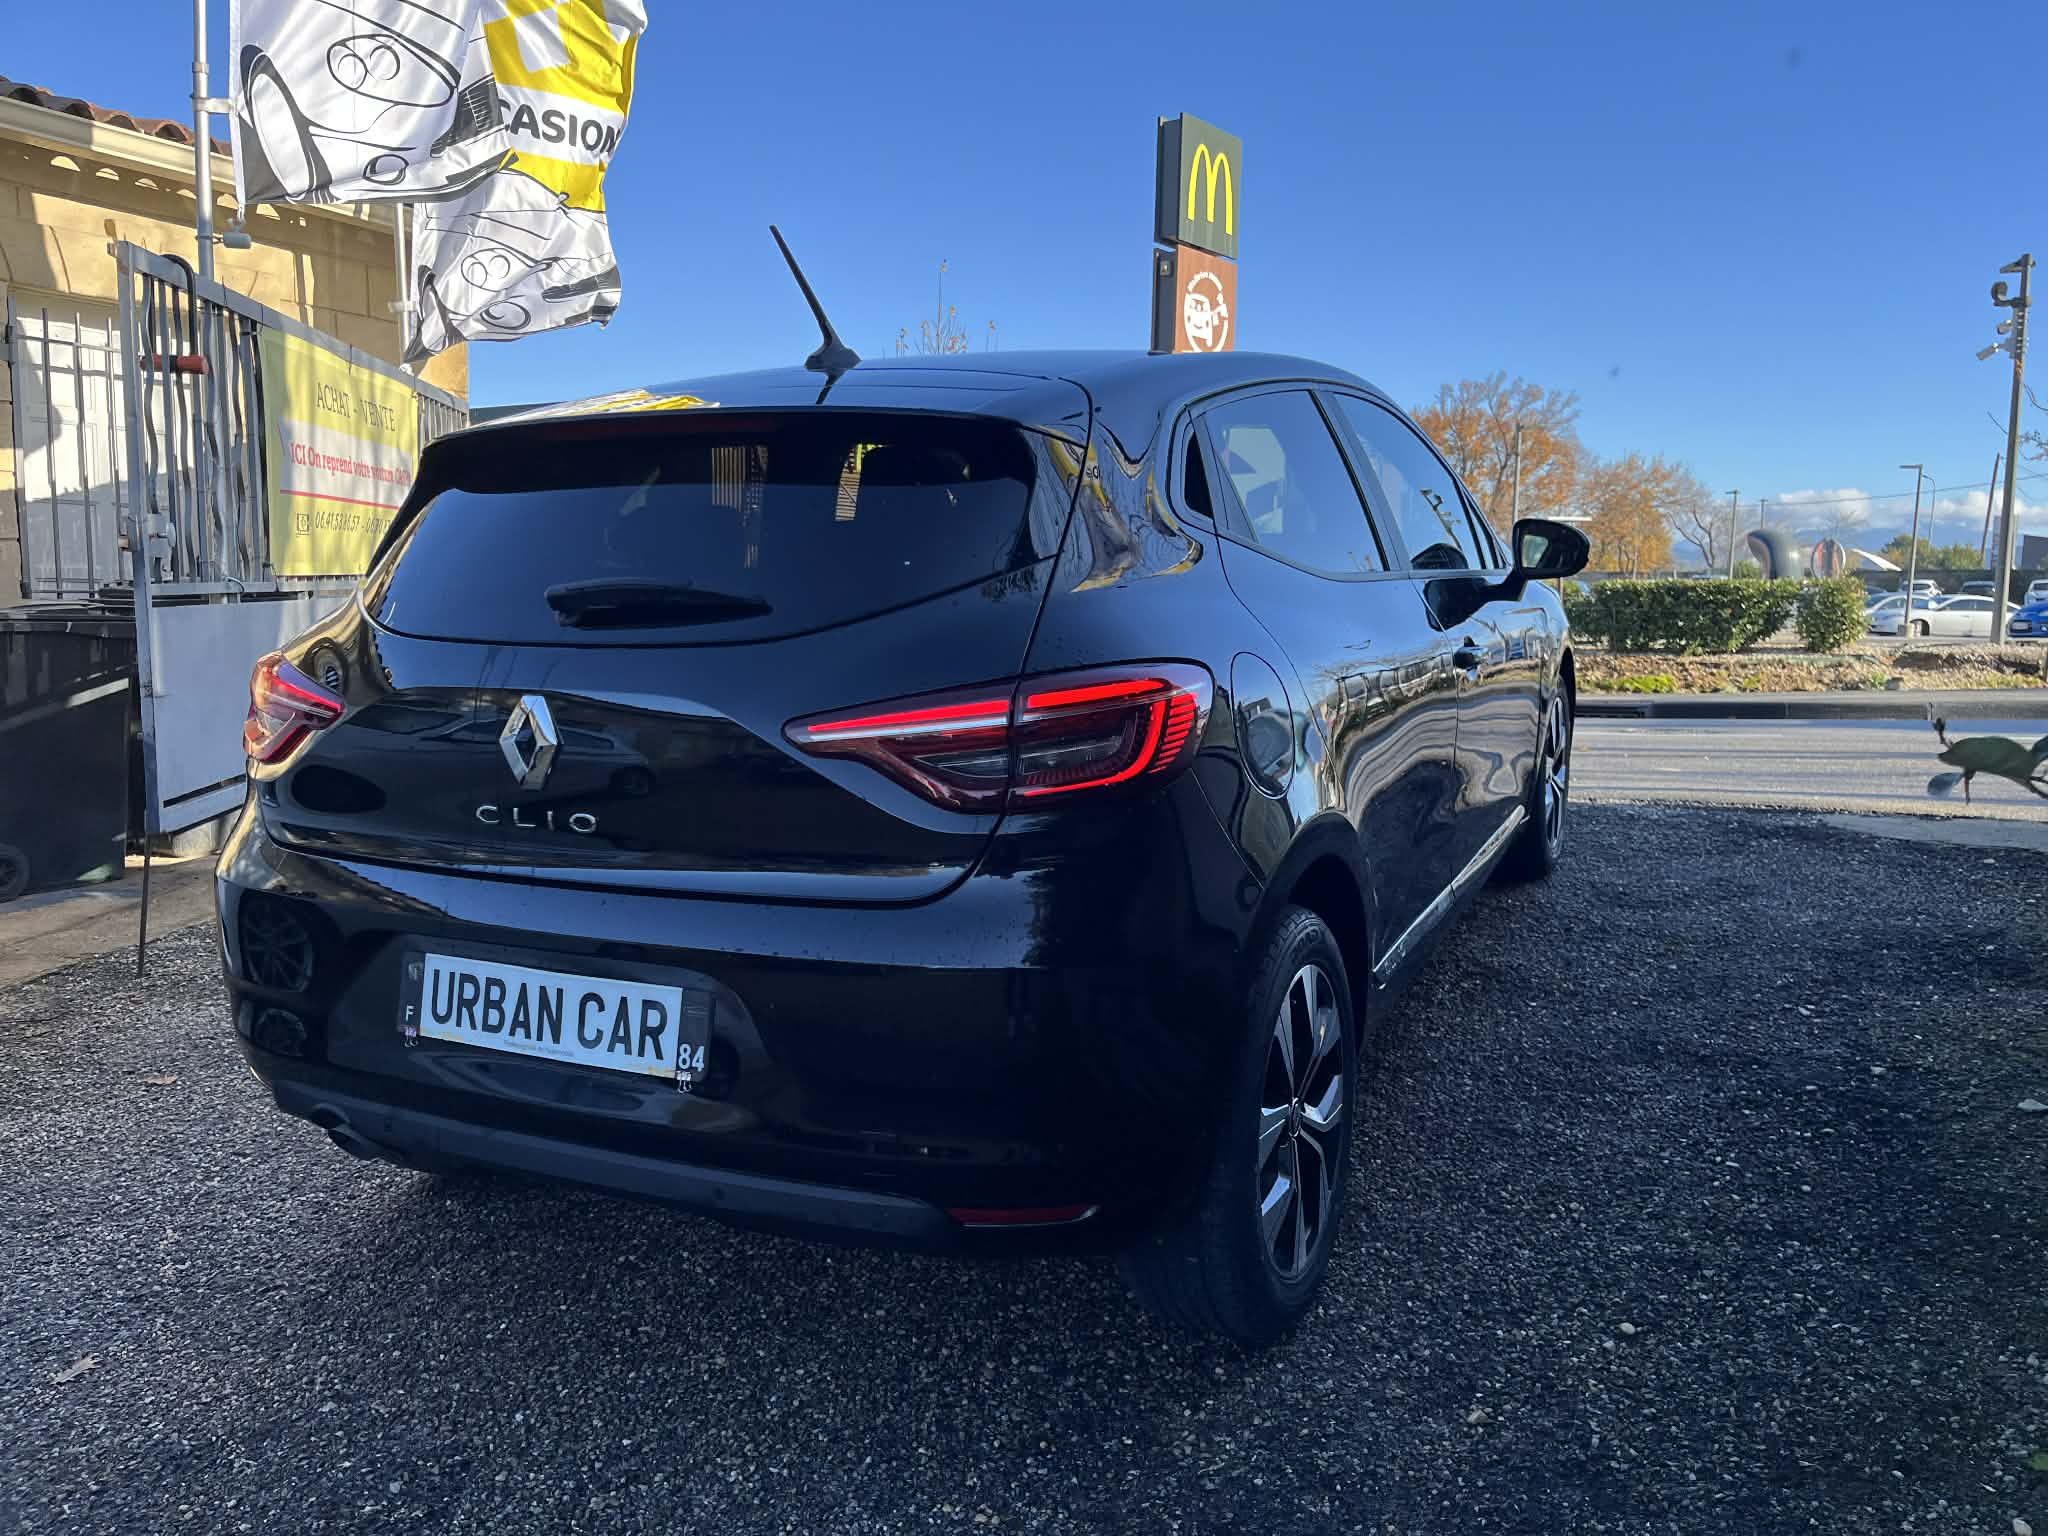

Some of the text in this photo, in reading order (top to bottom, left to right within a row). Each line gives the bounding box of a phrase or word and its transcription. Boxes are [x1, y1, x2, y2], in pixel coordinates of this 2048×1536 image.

[316, 382, 351, 419] ACHAT
[359, 399, 396, 432] VENTE
[290, 443, 306, 465] ICI
[308, 446, 321, 470] On
[321, 452, 353, 478] reprend
[476, 804, 598, 833] CLIO
[405, 1004, 415, 1021] F
[431, 968, 668, 1061] URBAN CAR
[678, 1043, 705, 1072] 84
